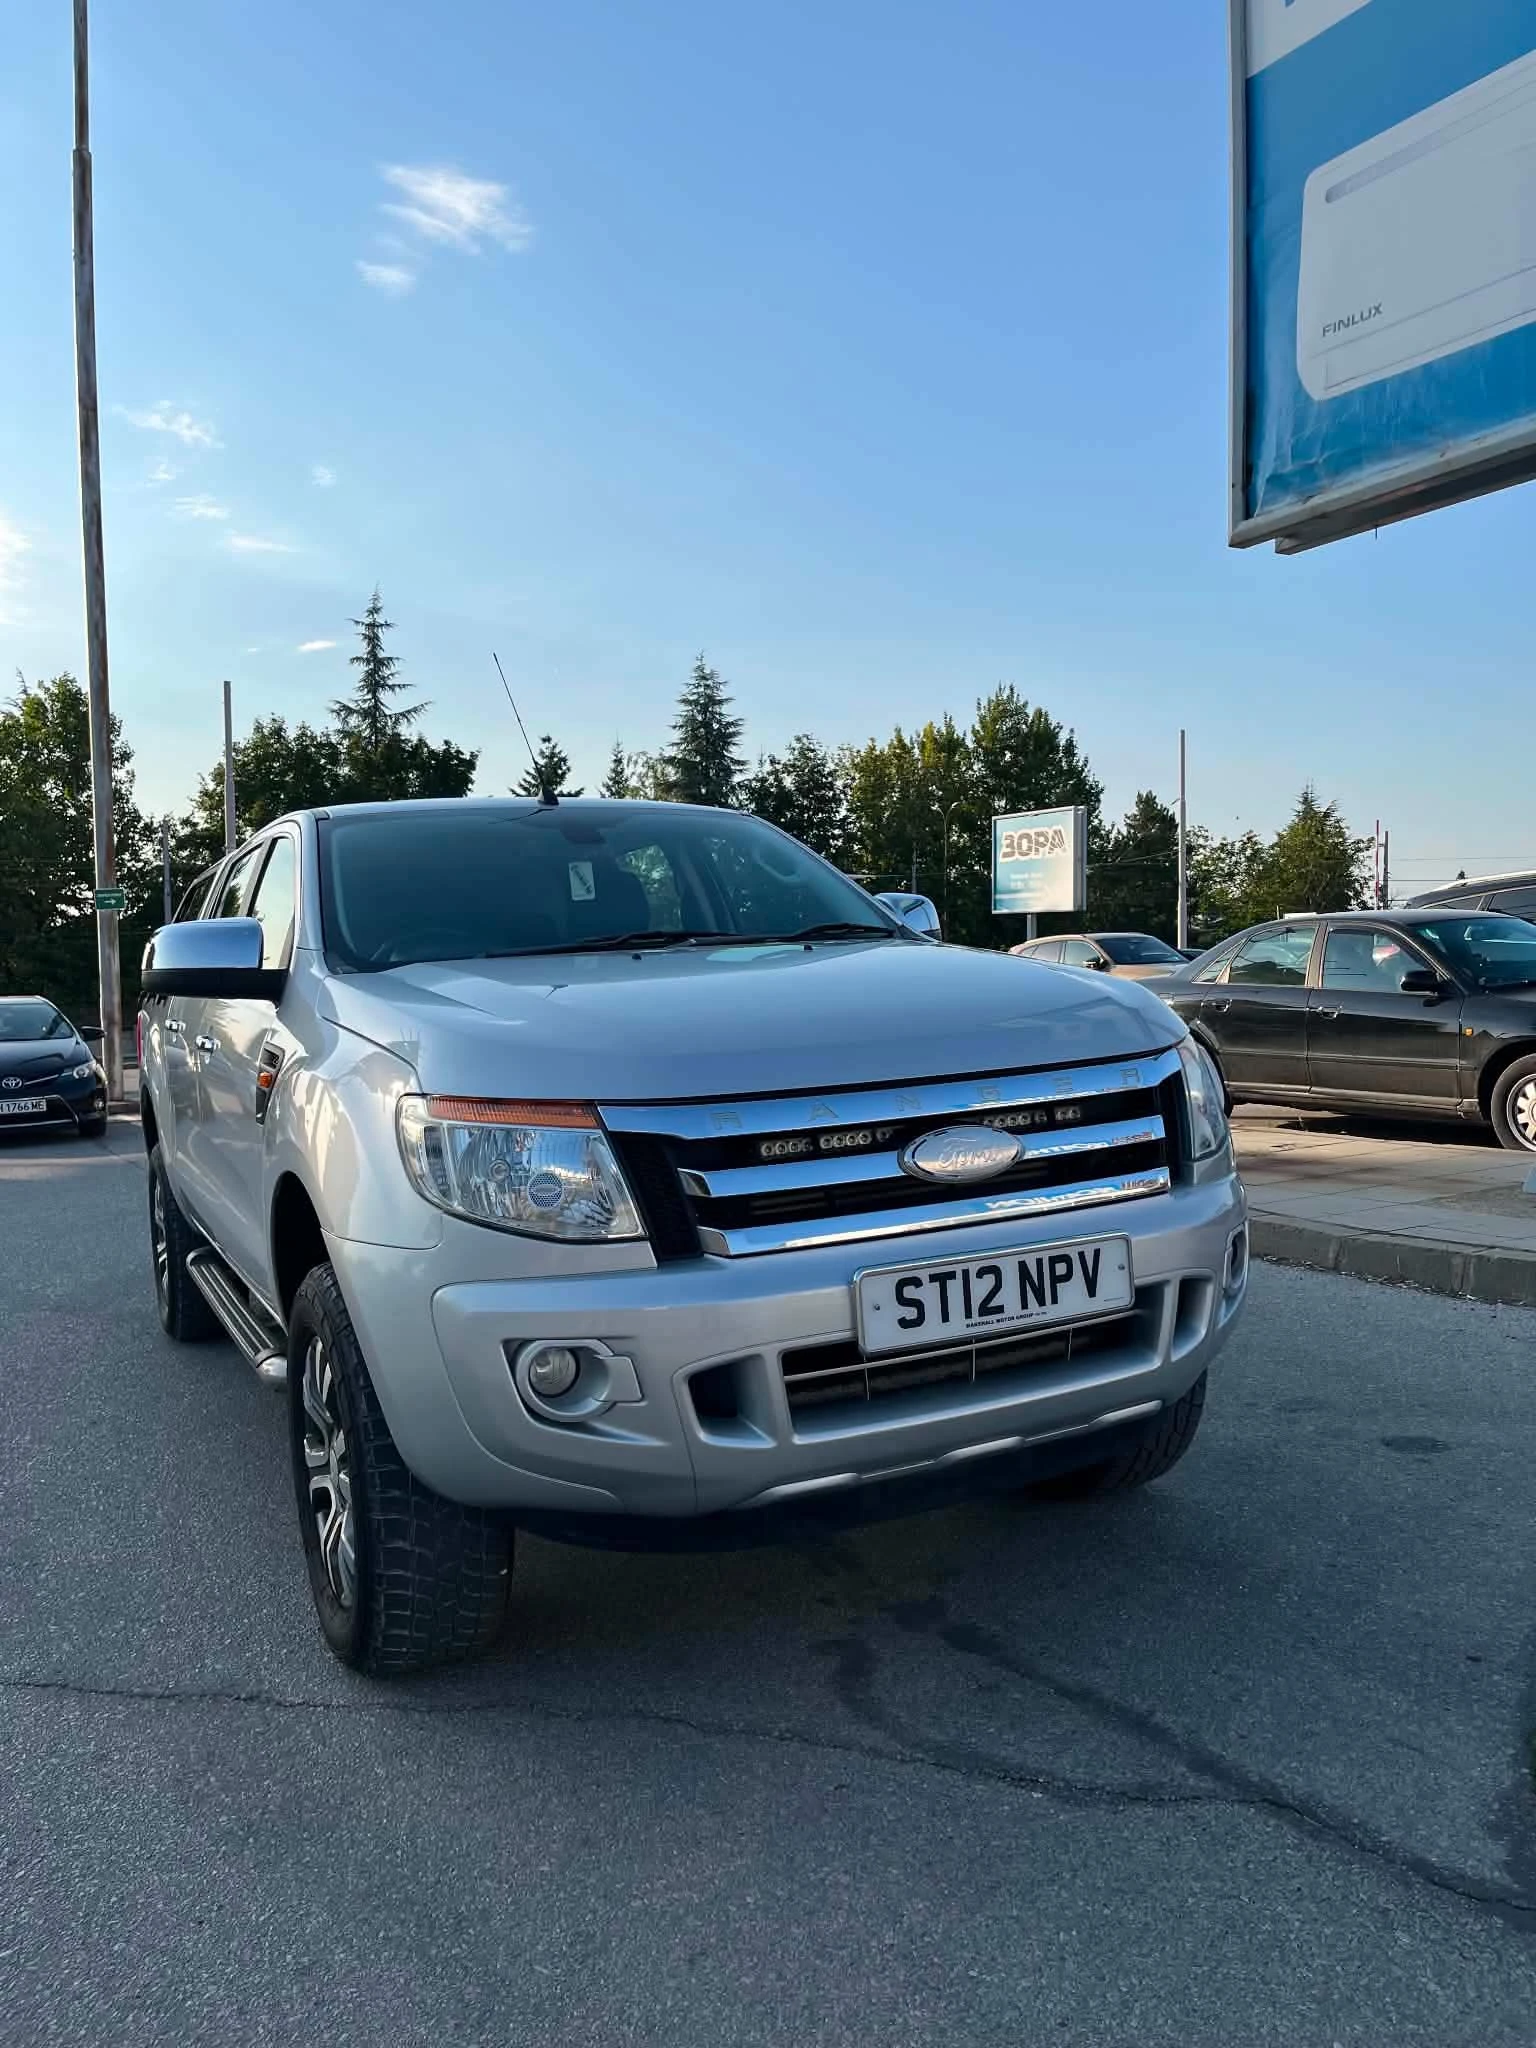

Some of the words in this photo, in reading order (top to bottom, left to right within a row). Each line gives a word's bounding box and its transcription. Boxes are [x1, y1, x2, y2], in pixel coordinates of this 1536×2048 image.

[1322, 302, 1383, 338] FINLUX
[1001, 827, 1066, 860] ЗОРА
[6, 1102, 30, 1113] 1766
[894, 1264, 1005, 1330] ST12
[1018, 1247, 1101, 1310] NPV
